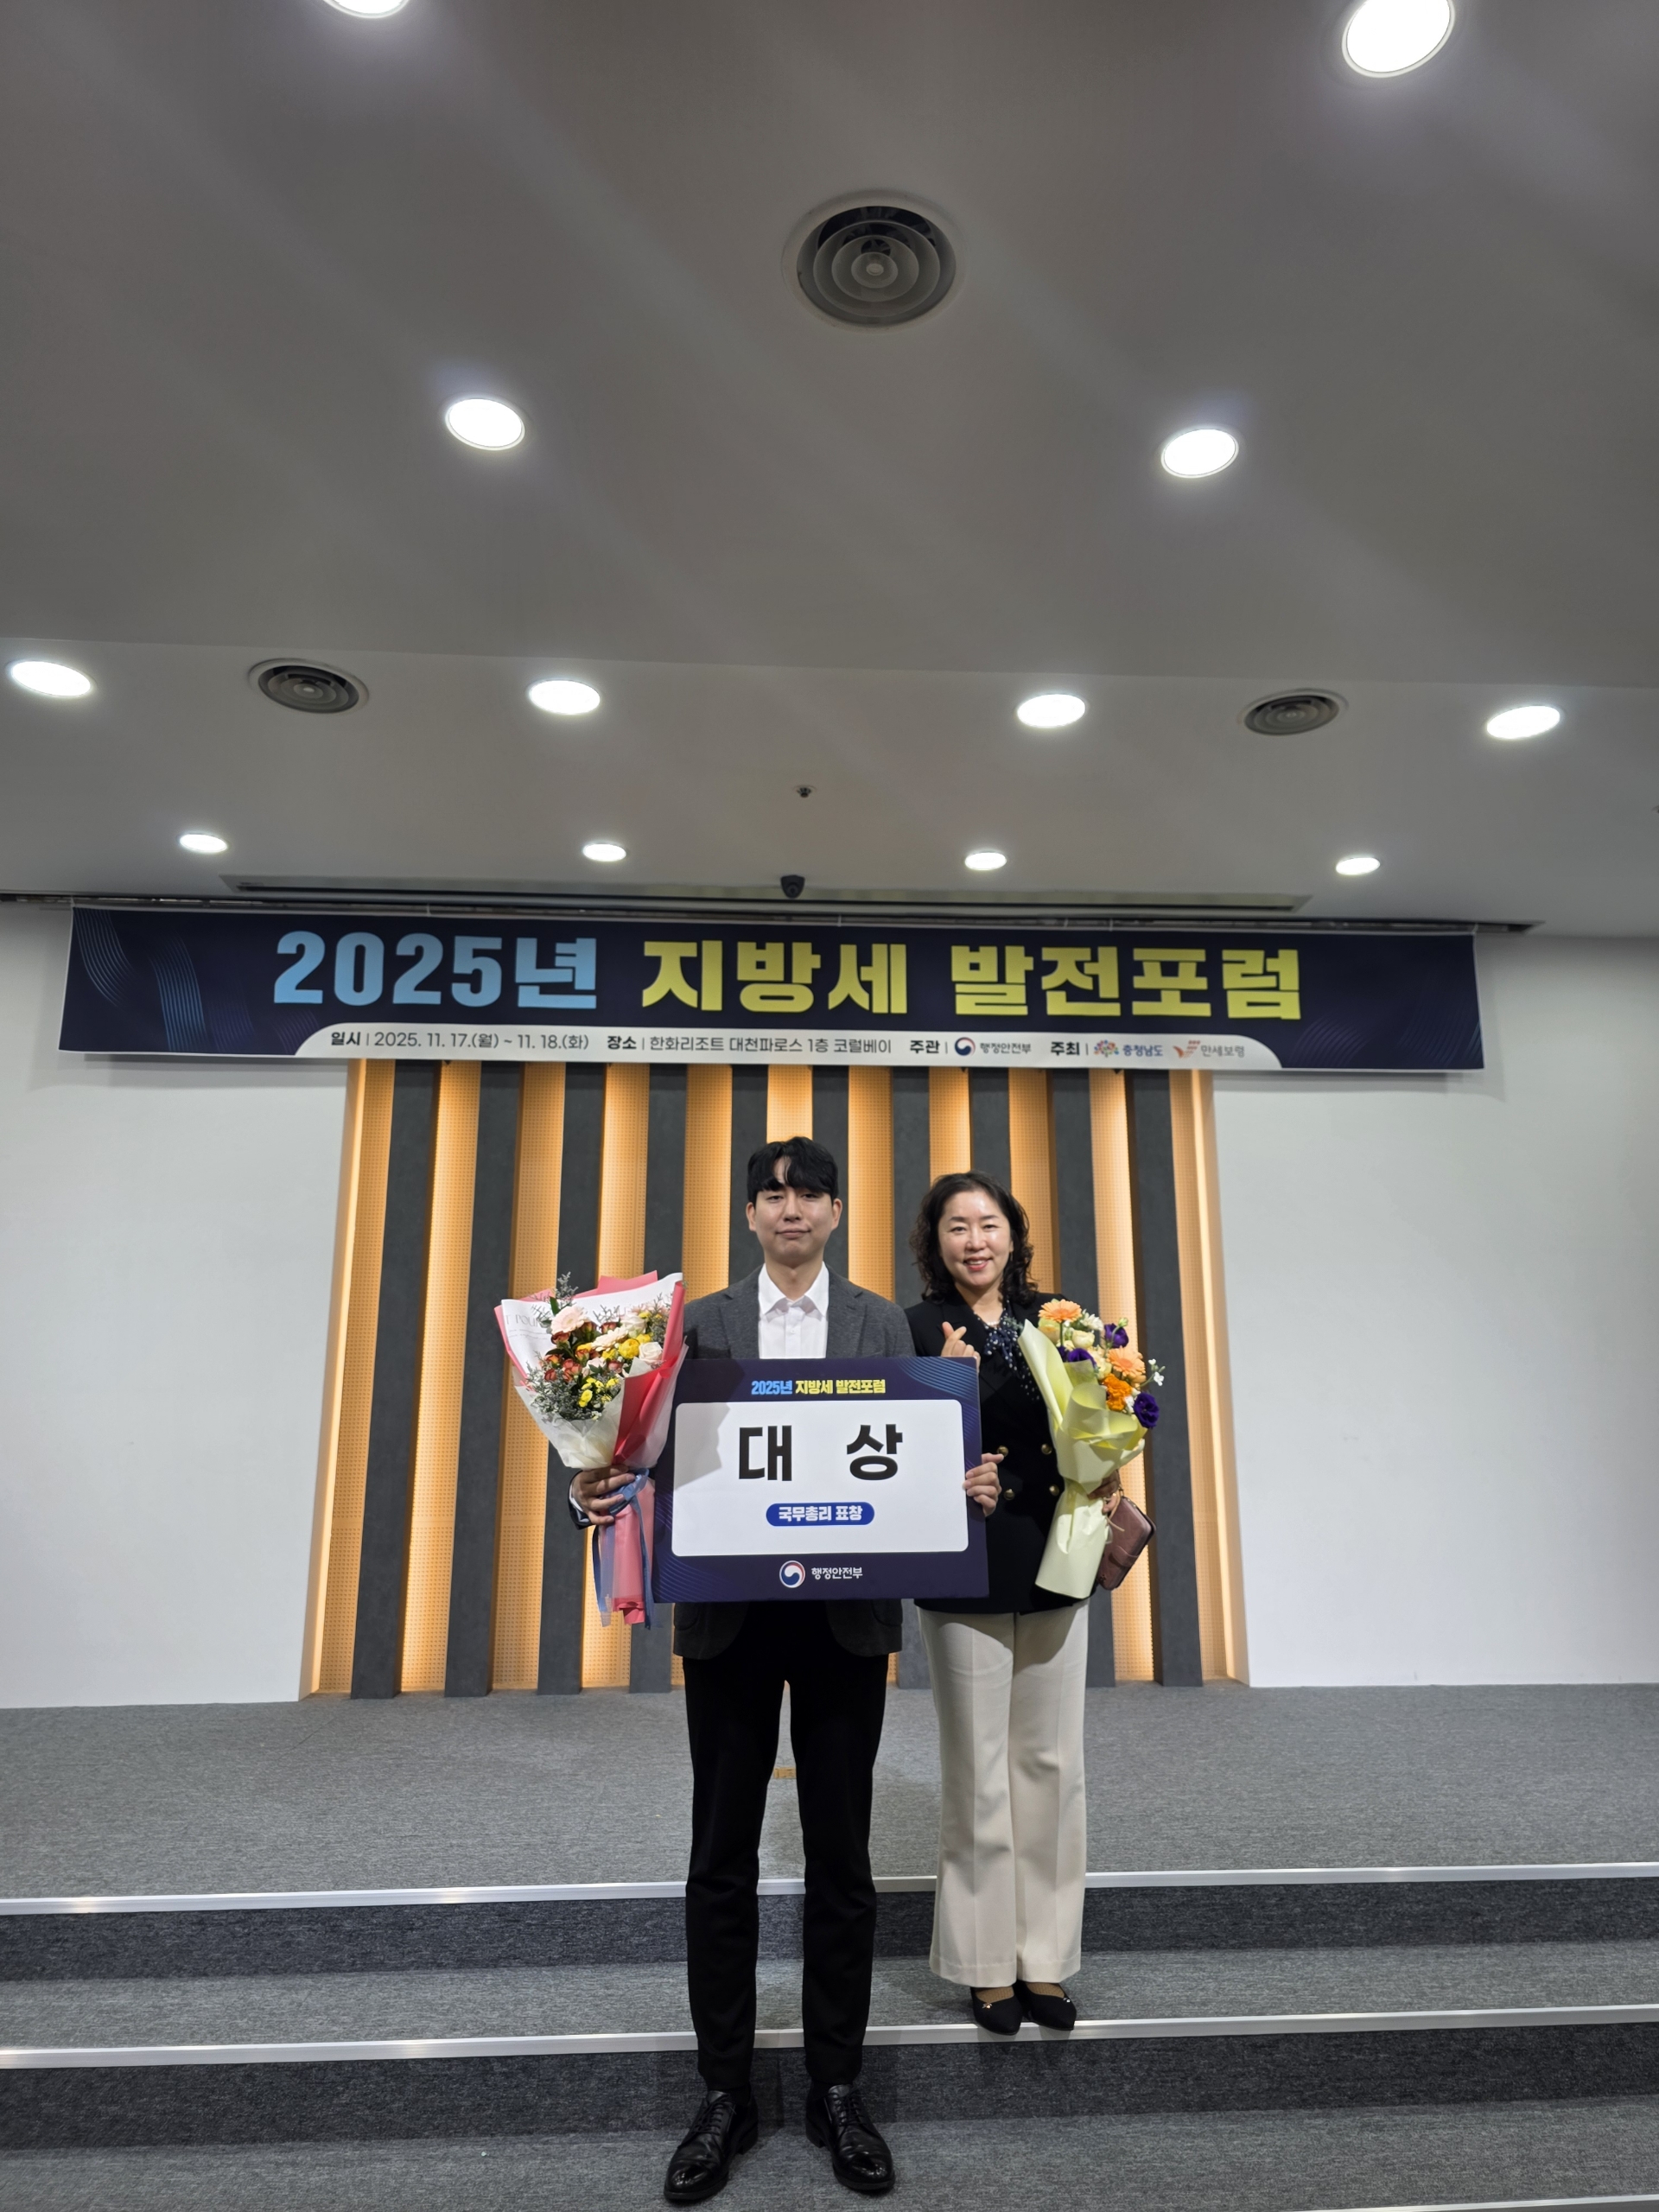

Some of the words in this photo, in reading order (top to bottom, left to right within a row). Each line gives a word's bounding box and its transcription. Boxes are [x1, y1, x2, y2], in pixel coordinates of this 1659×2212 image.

[273, 930, 597, 1010] 2025년
[641, 939, 908, 1014] 지방세
[950, 944, 1301, 1020] 발전포럼
[331, 1032, 360, 1046] 일시
[374, 1032, 422, 1046] 2025.
[607, 1035, 637, 1050] 장소
[650, 1036, 724, 1052] 한화리조트
[729, 1037, 803, 1052] 대천파로스
[808, 1038, 829, 1053] 1층
[834, 1039, 892, 1054] 코럴베이
[910, 1039, 939, 1055] 주관
[980, 1042, 1032, 1055] 행정안전부
[1051, 1041, 1080, 1056] 주최
[1122, 1044, 1163, 1057] 충청남도
[1200, 1044, 1245, 1058] 만세보령
[751, 1380, 793, 1395] 2025년
[795, 1379, 834, 1395] 지방세
[836, 1378, 887, 1395] 발전포럼
[739, 1424, 792, 1481] 대
[846, 1423, 904, 1481] 상
[779, 1506, 832, 1522] 국무총리
[836, 1505, 863, 1522] 표창
[811, 1566, 863, 1580] 행정안전부
